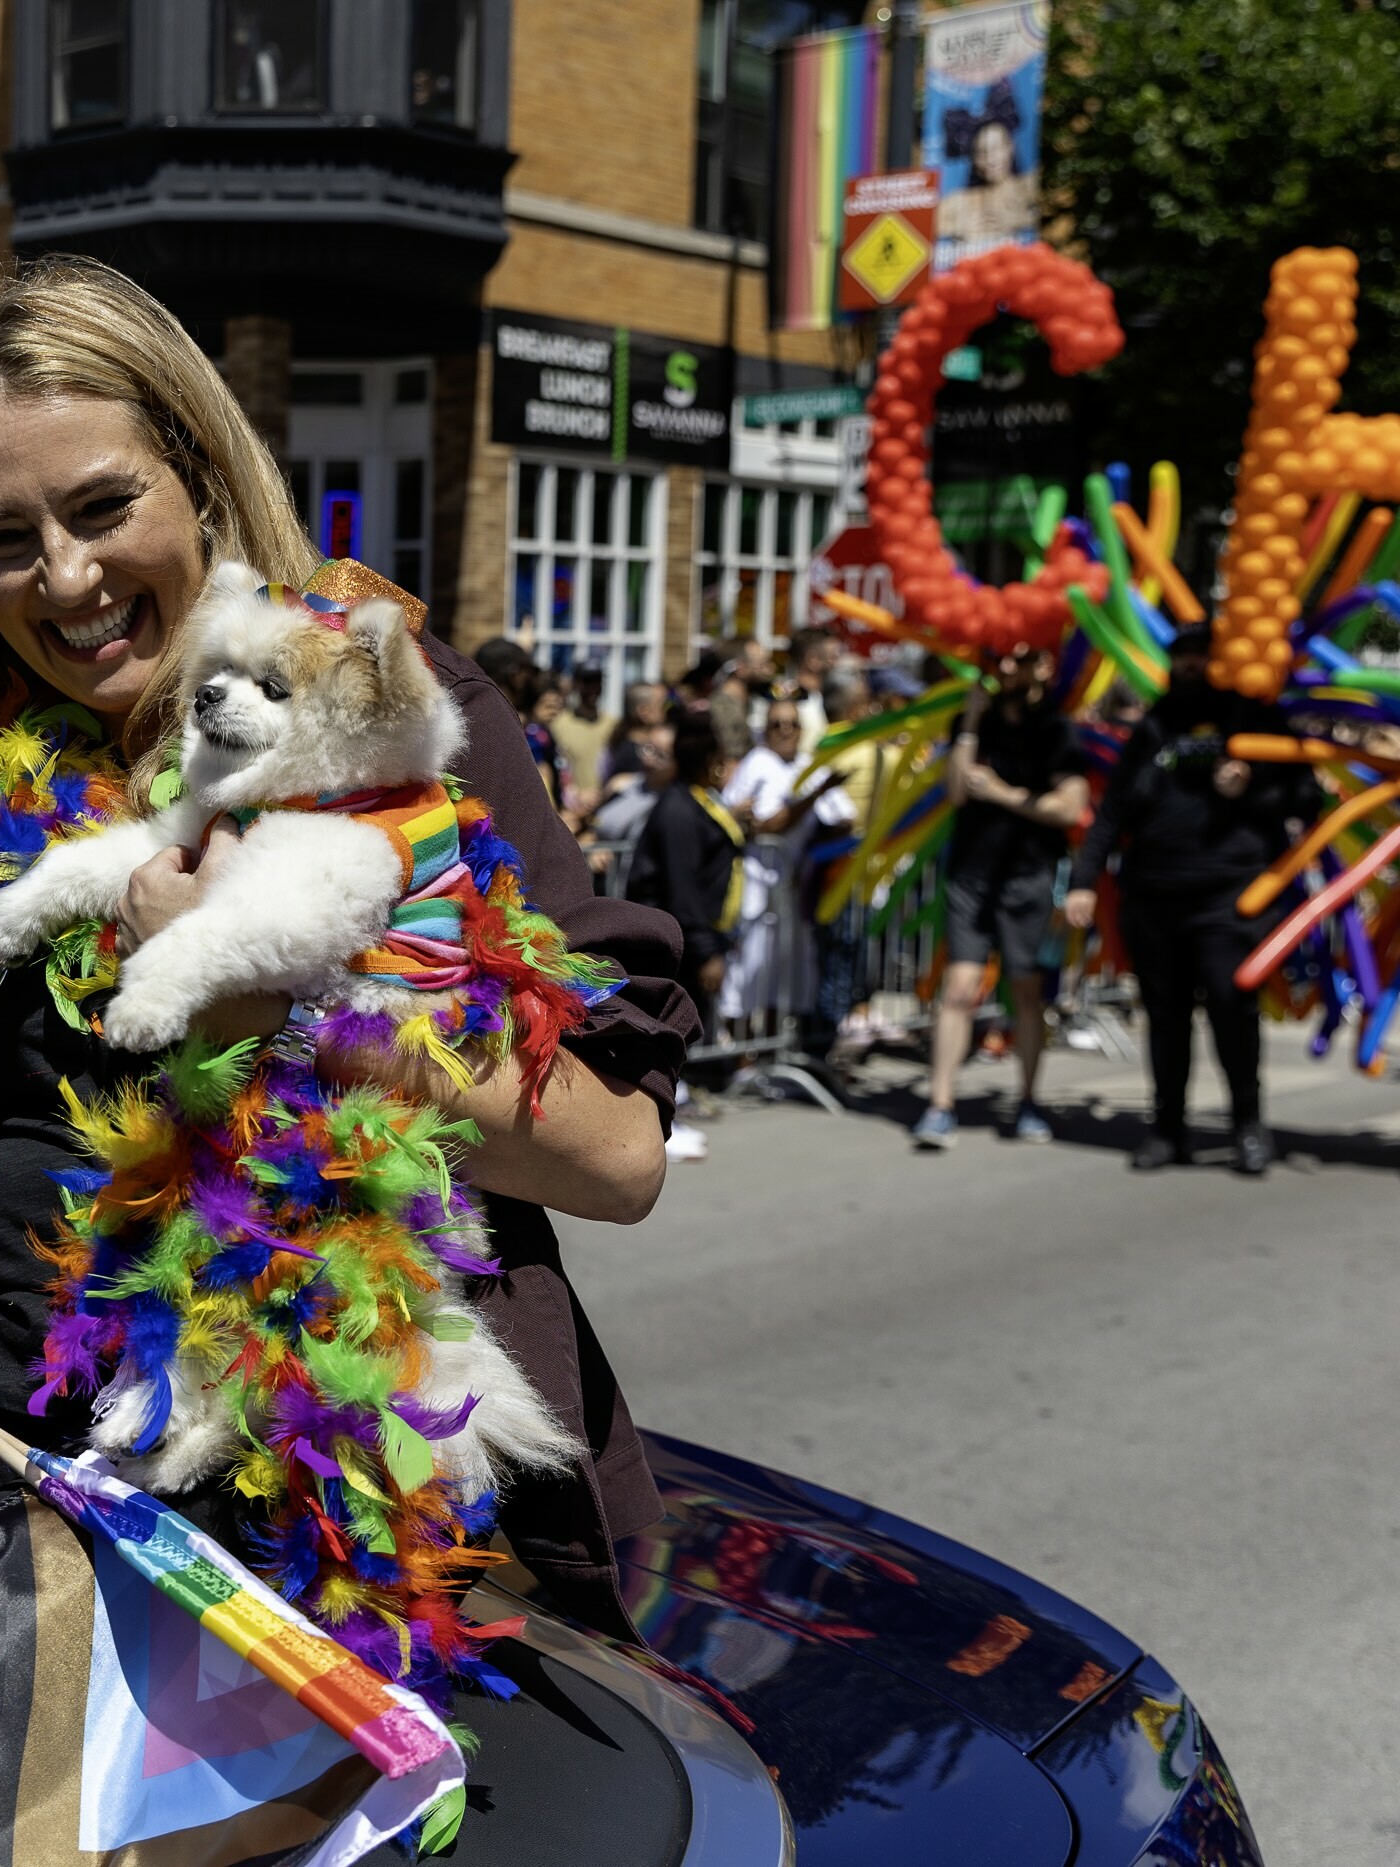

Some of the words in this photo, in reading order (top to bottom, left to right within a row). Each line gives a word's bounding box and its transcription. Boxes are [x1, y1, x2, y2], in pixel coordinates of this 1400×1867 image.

[498, 326, 610, 371] BREAKFAST
[540, 367, 611, 408] LUNCH
[524, 399, 611, 441] BRUNCH
